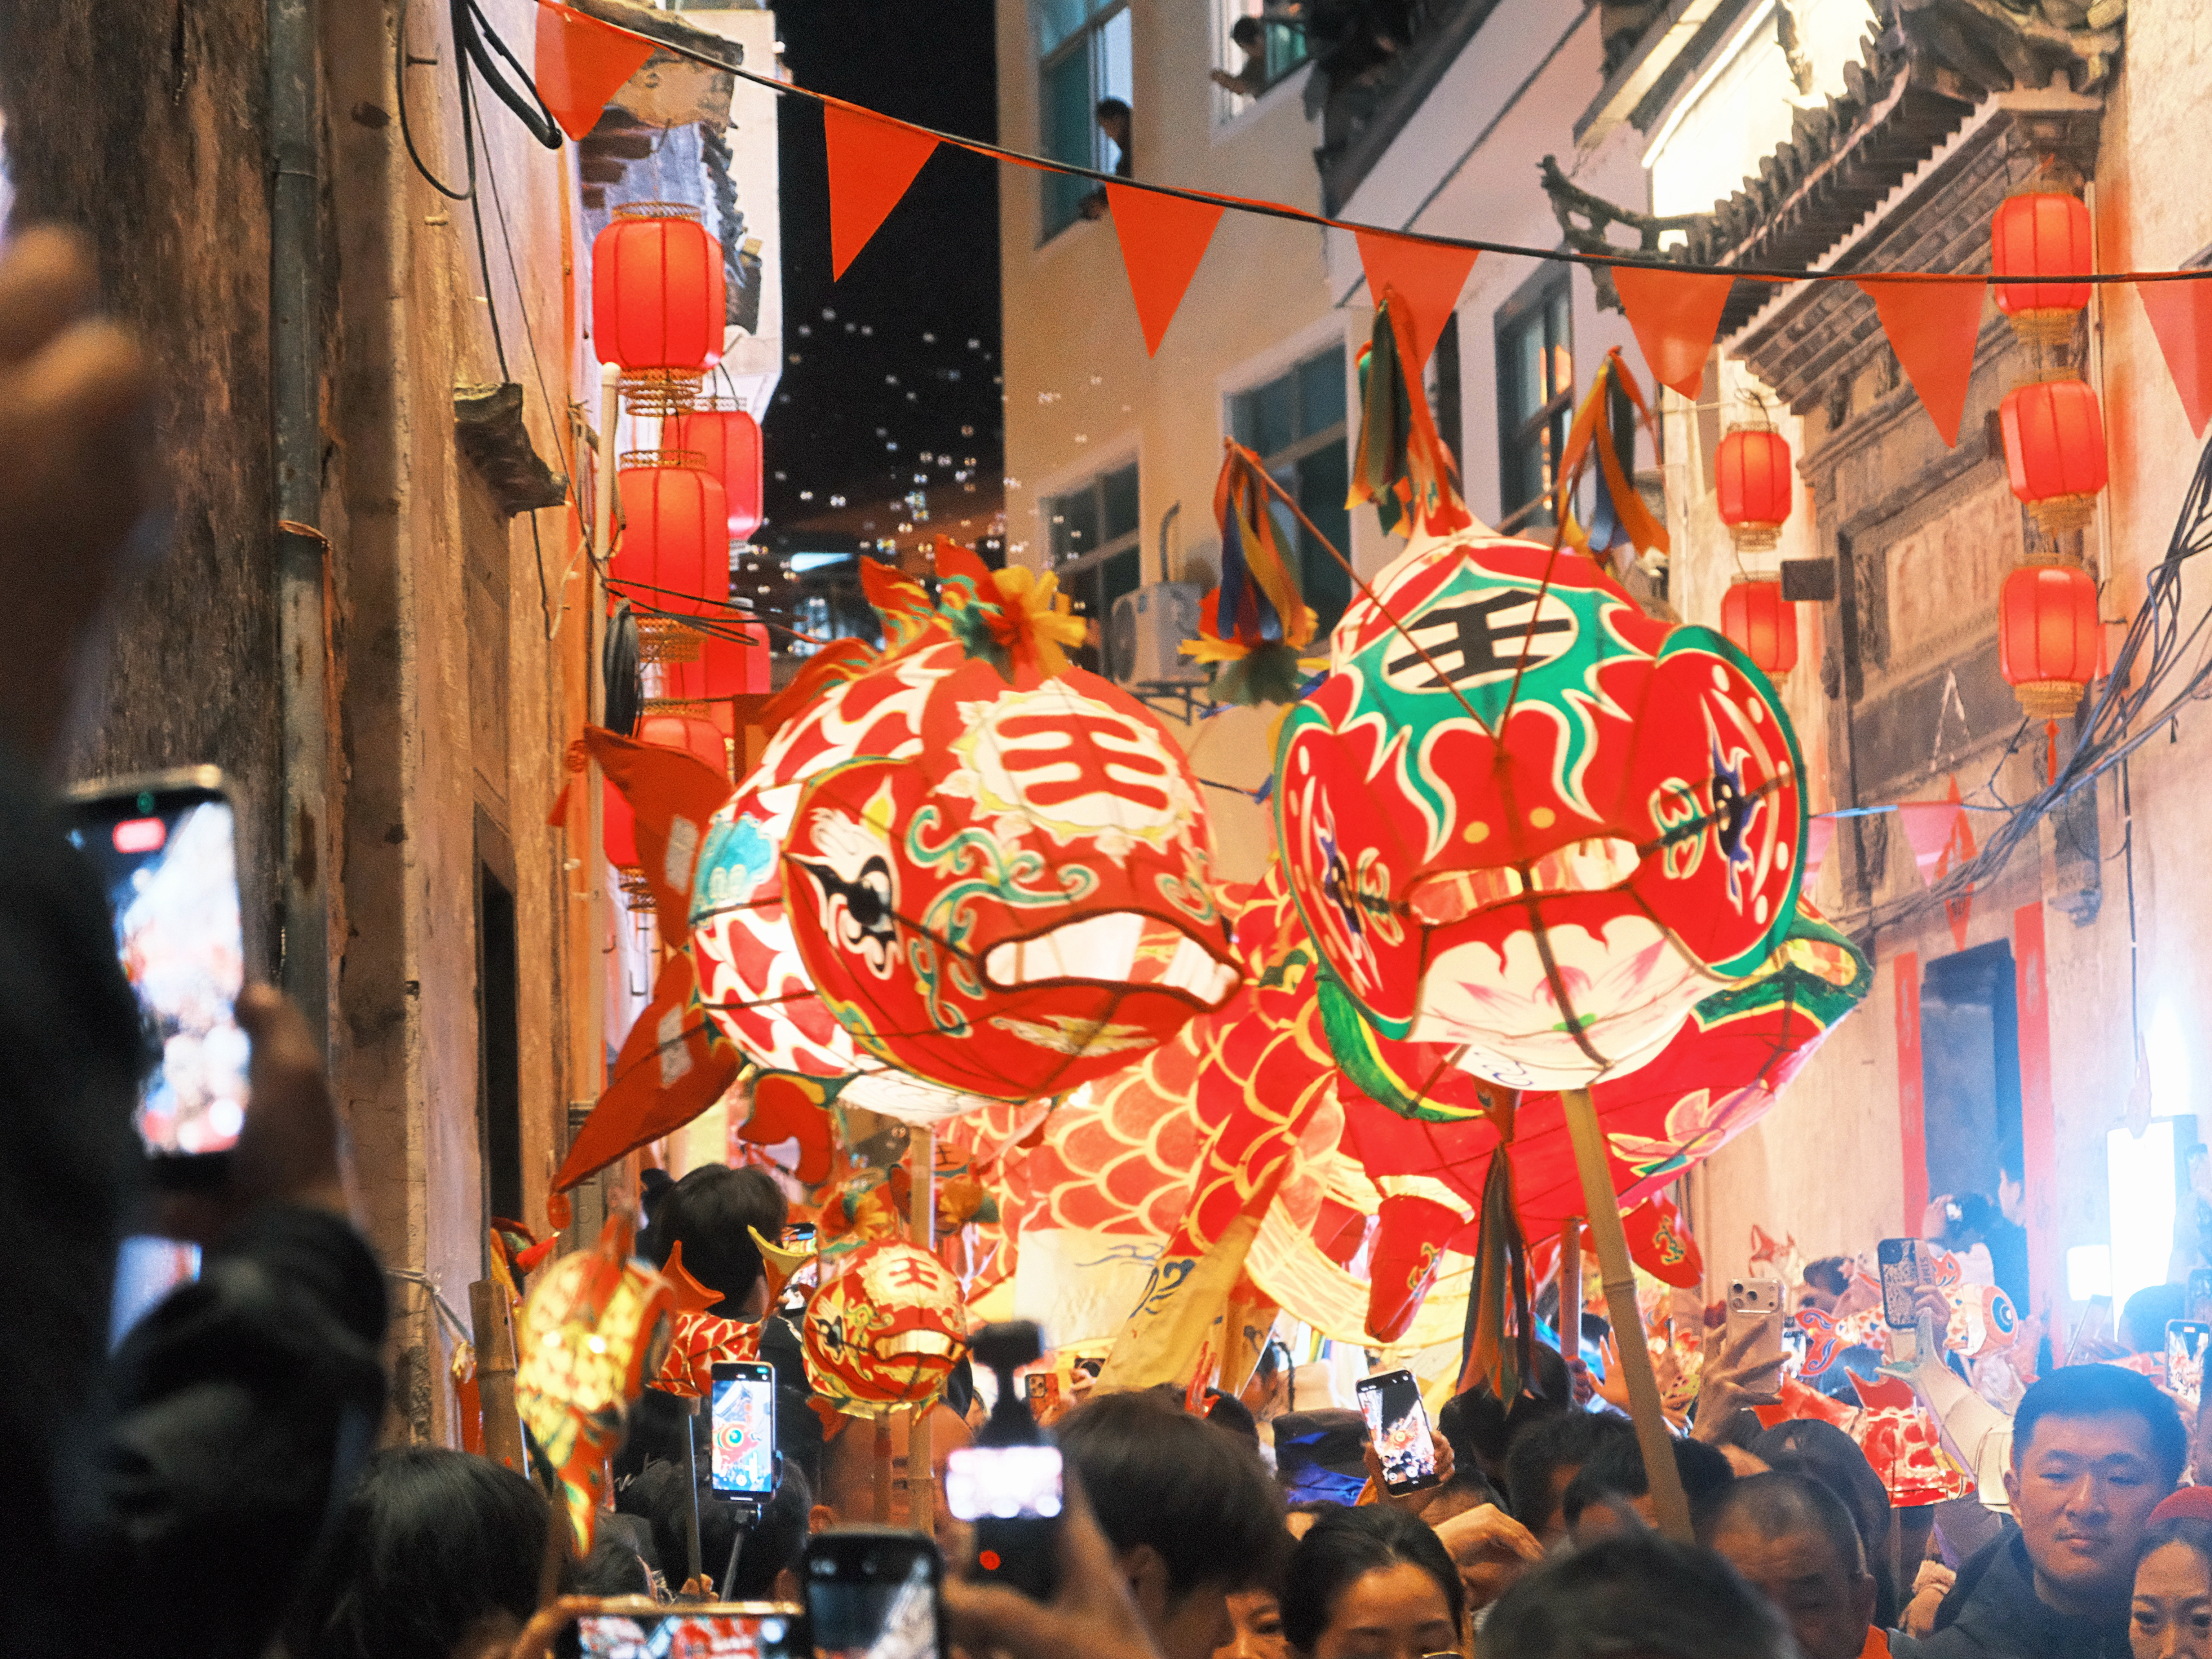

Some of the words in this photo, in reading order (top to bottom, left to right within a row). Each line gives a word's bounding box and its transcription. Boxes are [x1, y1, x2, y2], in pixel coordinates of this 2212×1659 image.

[1388, 589, 1572, 688] 王
[996, 713, 1169, 811] 王
[888, 1257, 939, 1291] 王
